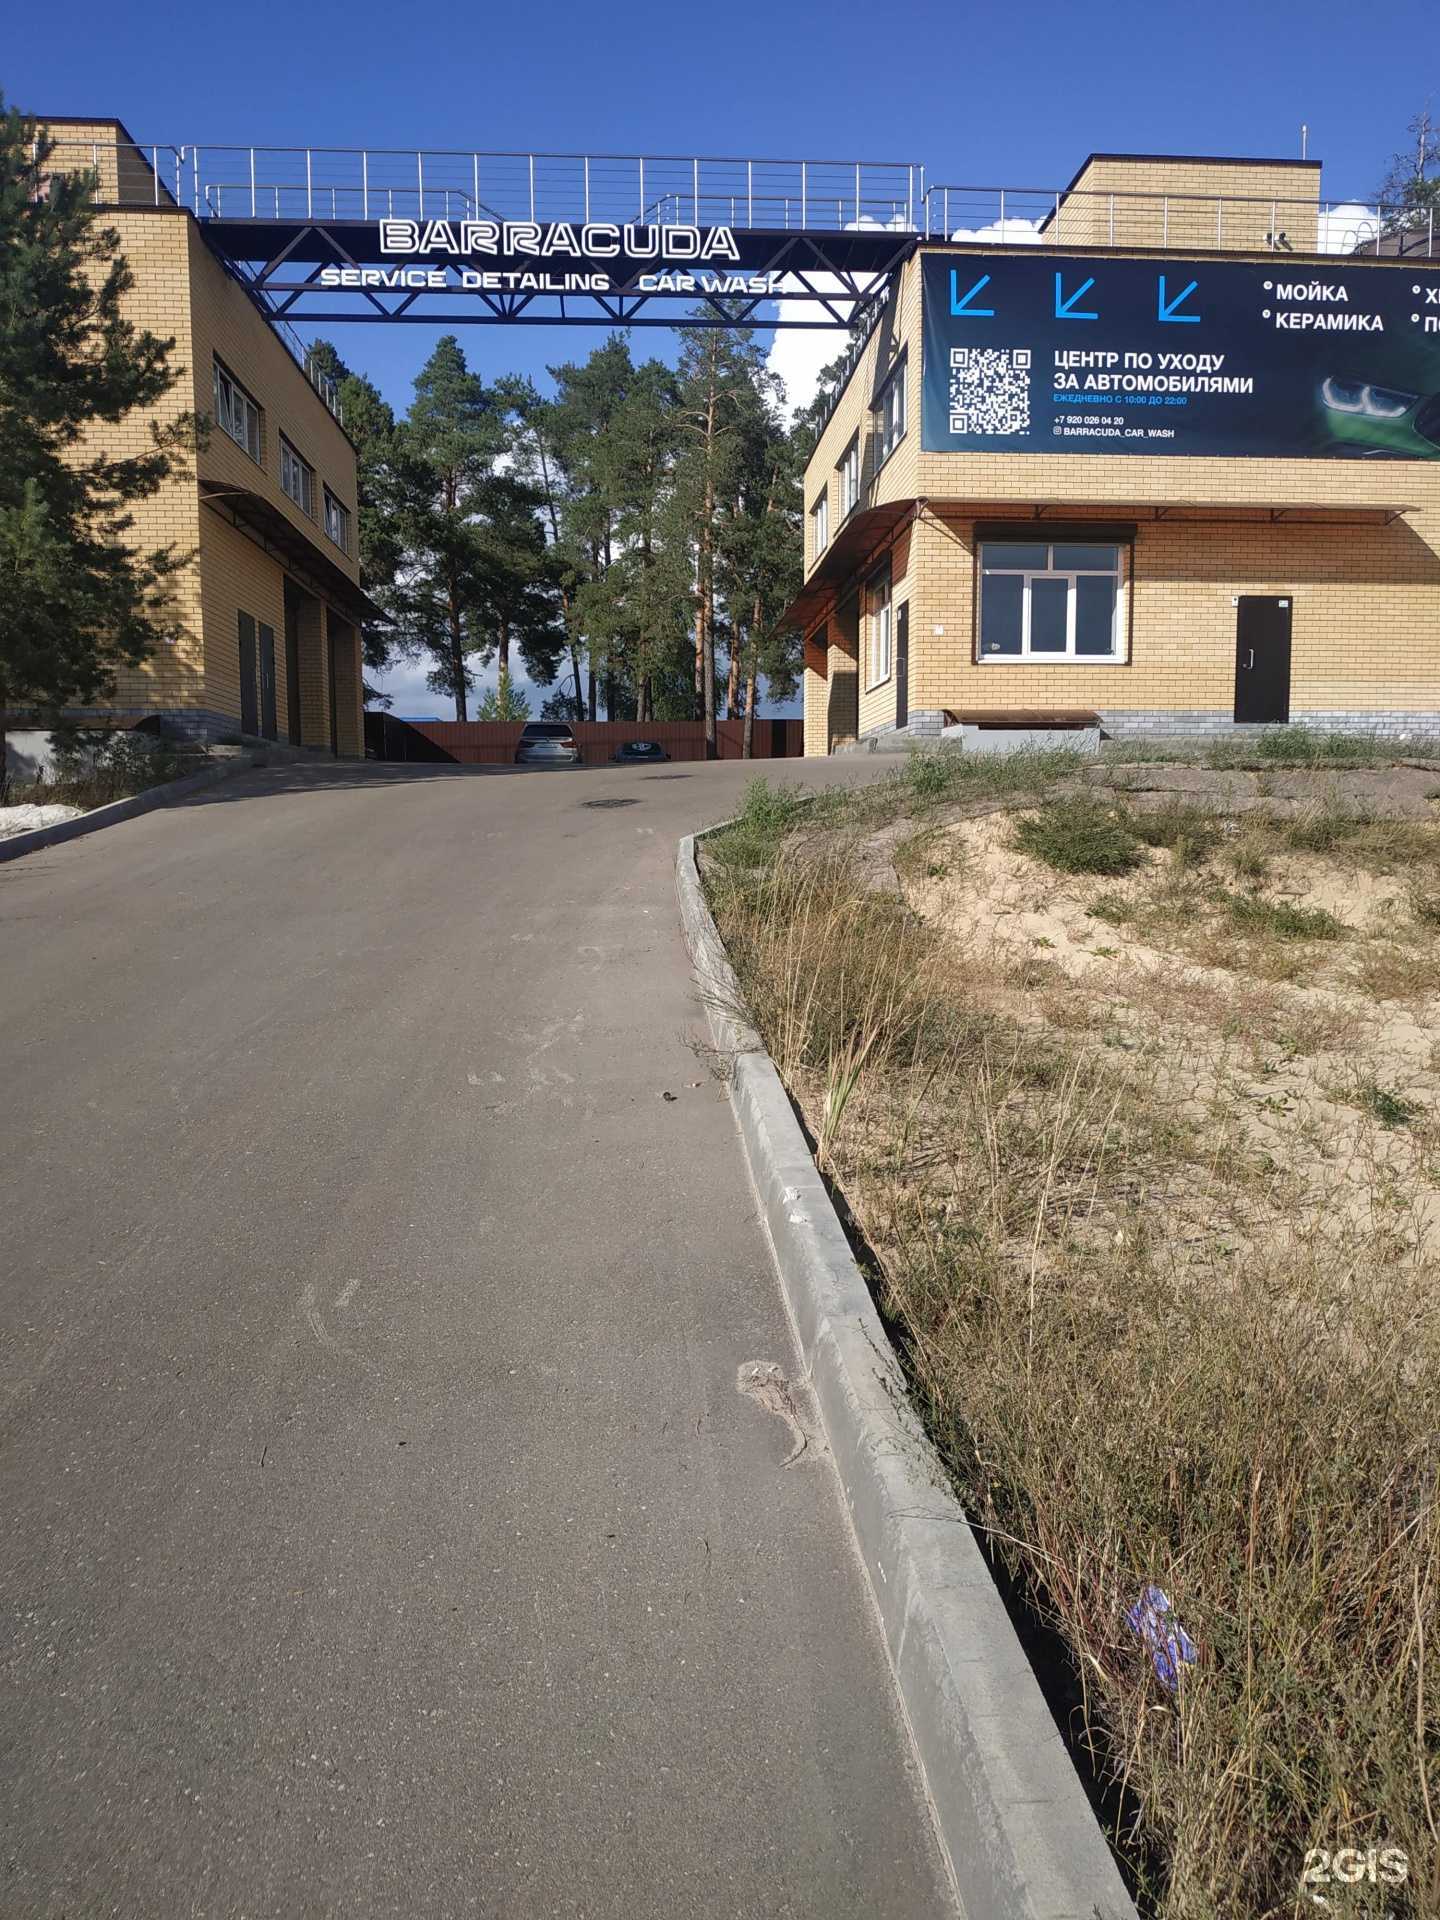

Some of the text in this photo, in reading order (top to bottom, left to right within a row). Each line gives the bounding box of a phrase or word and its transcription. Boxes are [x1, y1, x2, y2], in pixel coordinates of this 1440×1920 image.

[379, 218, 741, 261] BARRACUDA
[320, 269, 788, 294] SERVICE DETAILING CAR WASH
[1276, 281, 1349, 302] МОЙКА
[1425, 287, 1440, 304] Х
[1275, 312, 1384, 332] КЕРАМИКА
[1424, 316, 1440, 333] П
[1054, 350, 1225, 373] ЦЕНТР ПО УХОДУ
[1053, 373, 1254, 394] ЗА АВТОМОБИЛЯМИ
[1053, 393, 1188, 405] ЕЖЕДНЕВНО С 10:00 ДО 22:00
[1054, 416, 1065, 424] +7
[1066, 416, 1083, 424] 920
[1101, 416, 1112, 424] 04
[1113, 417, 1125, 425] 20
[1063, 427, 1175, 438] BARRACUDA_CAR_WASH
